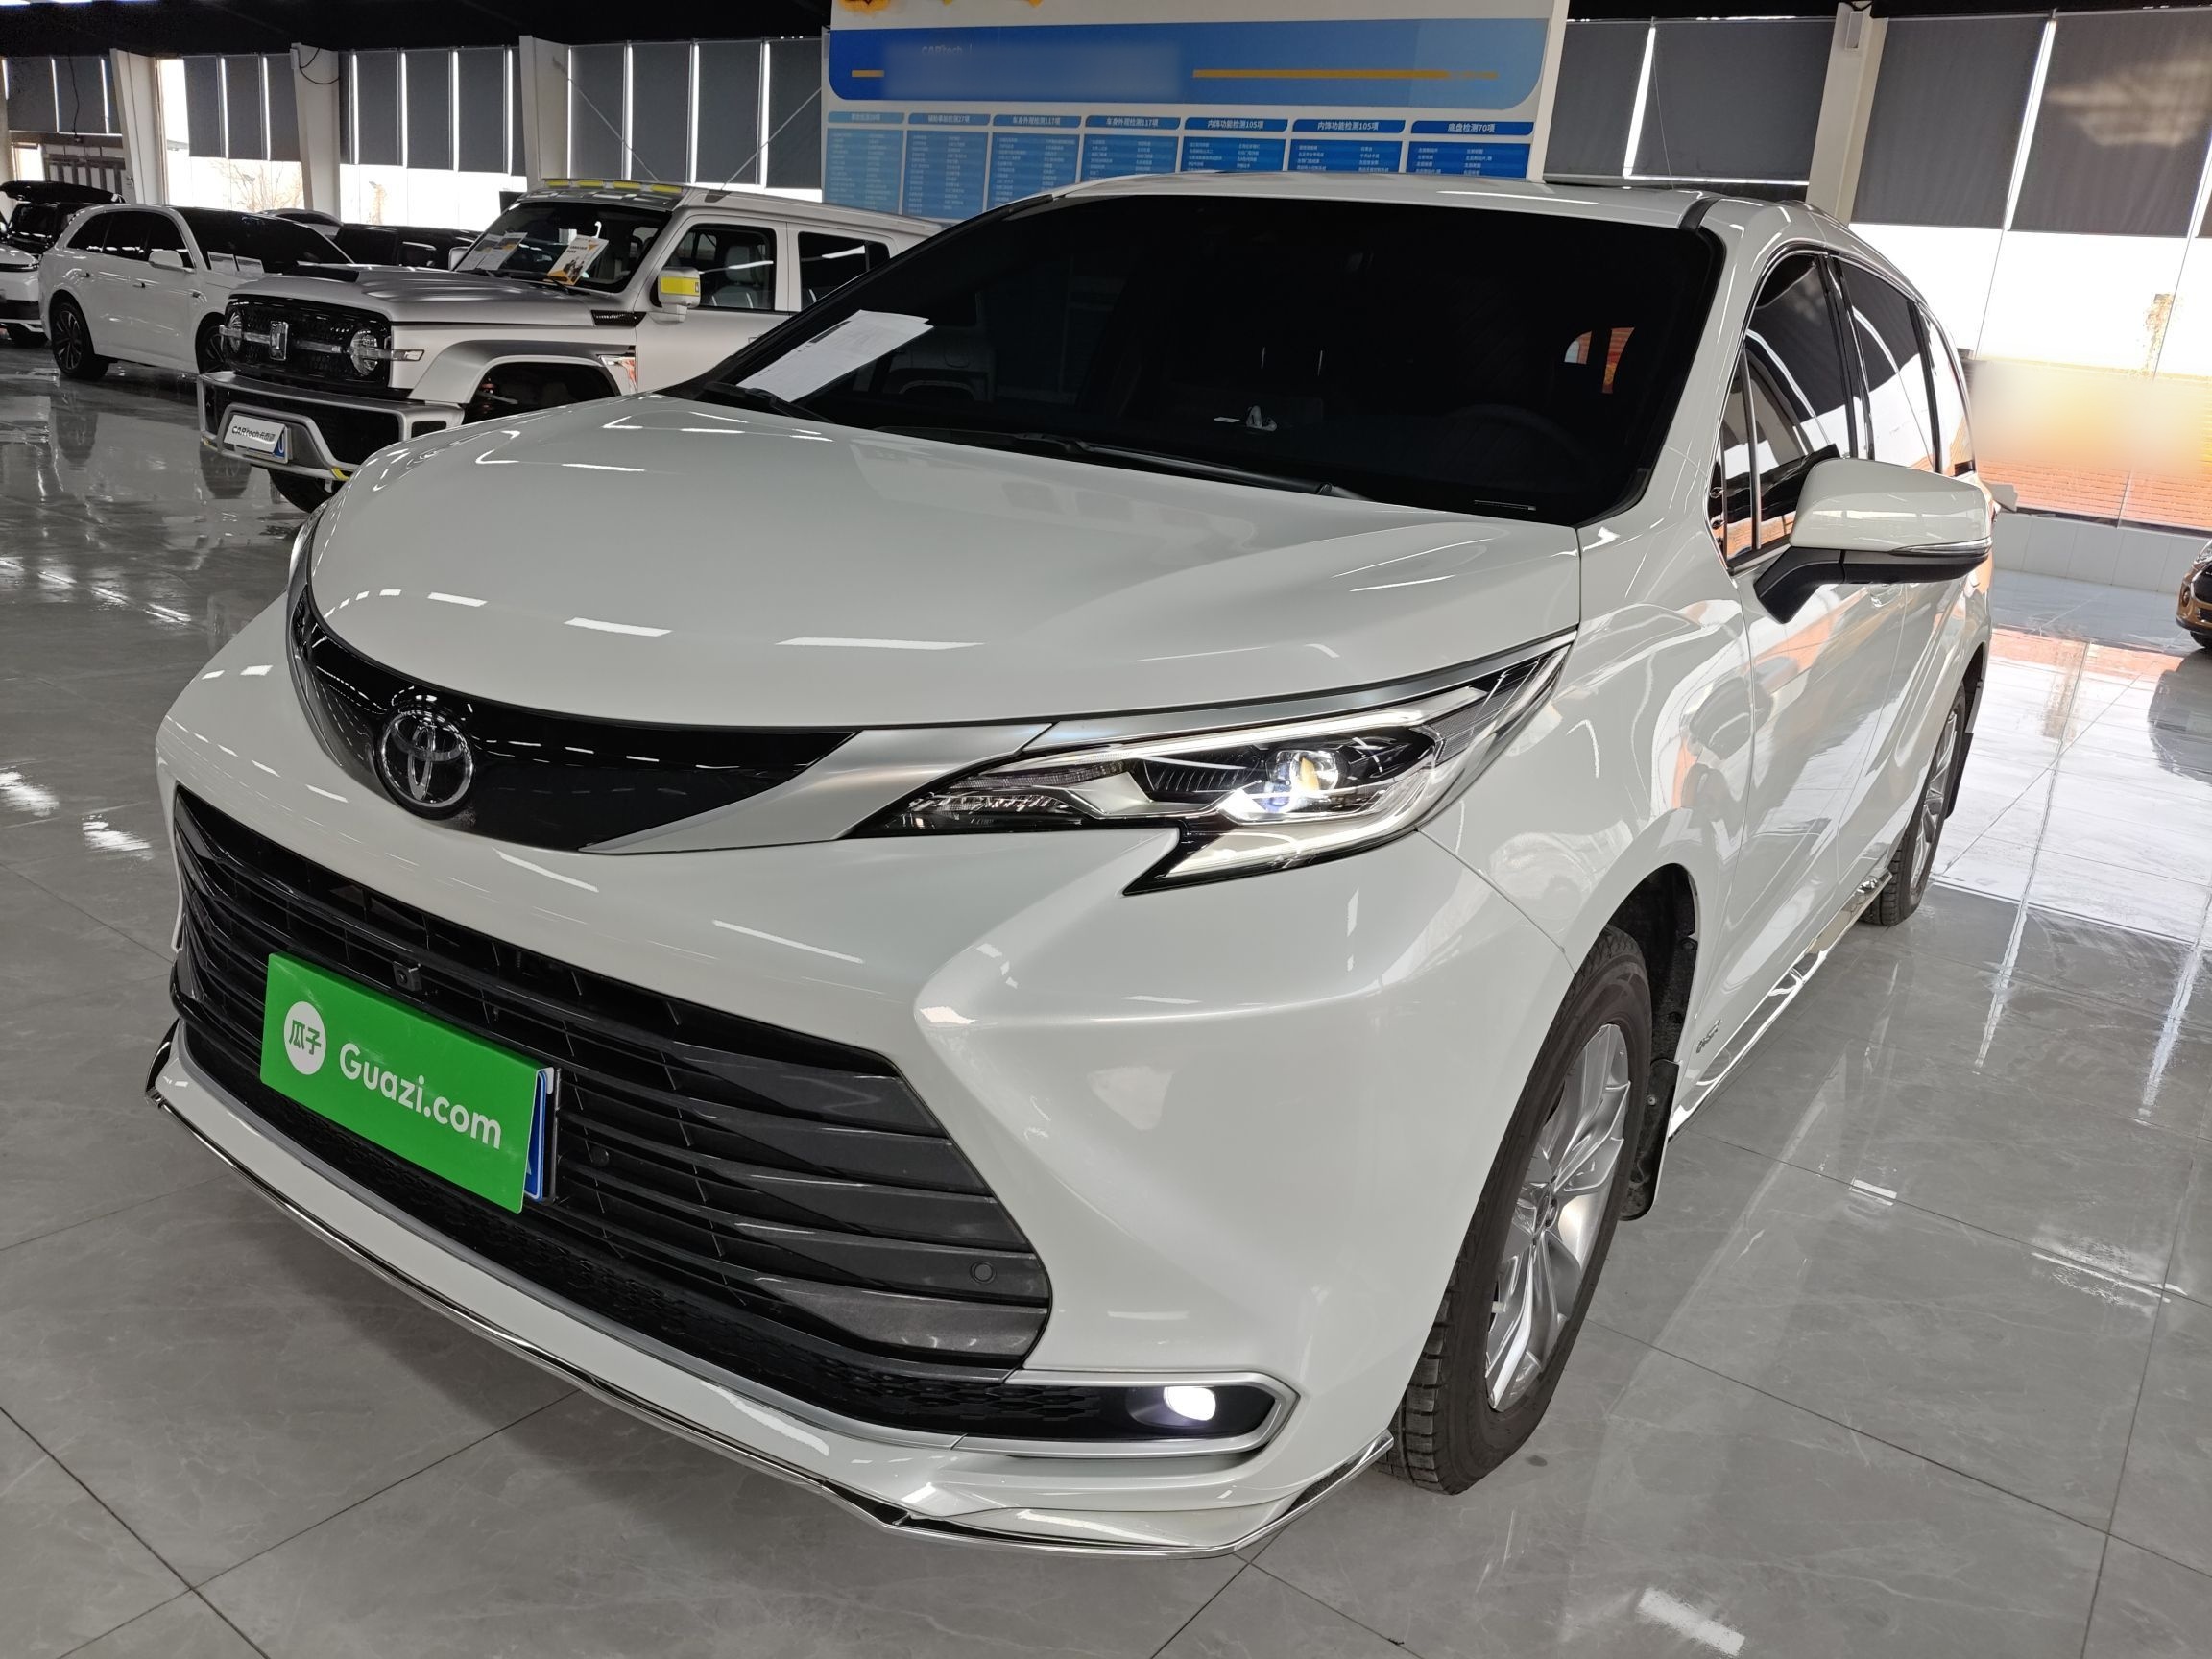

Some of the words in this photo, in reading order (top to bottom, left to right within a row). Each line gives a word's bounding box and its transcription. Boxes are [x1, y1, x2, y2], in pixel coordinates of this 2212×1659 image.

[1013, 116, 1061, 126] 车身外观检测117项
[1106, 118, 1159, 128] 车身外观检测117项
[1208, 119, 1263, 130] 内饰功能检测105项
[1317, 121, 1379, 132] 内饰功能检测105项
[1447, 123, 1495, 133] 底盘检测70项
[288, 1019, 322, 1055] 瓜子
[339, 1043, 502, 1150] Guazi.com
